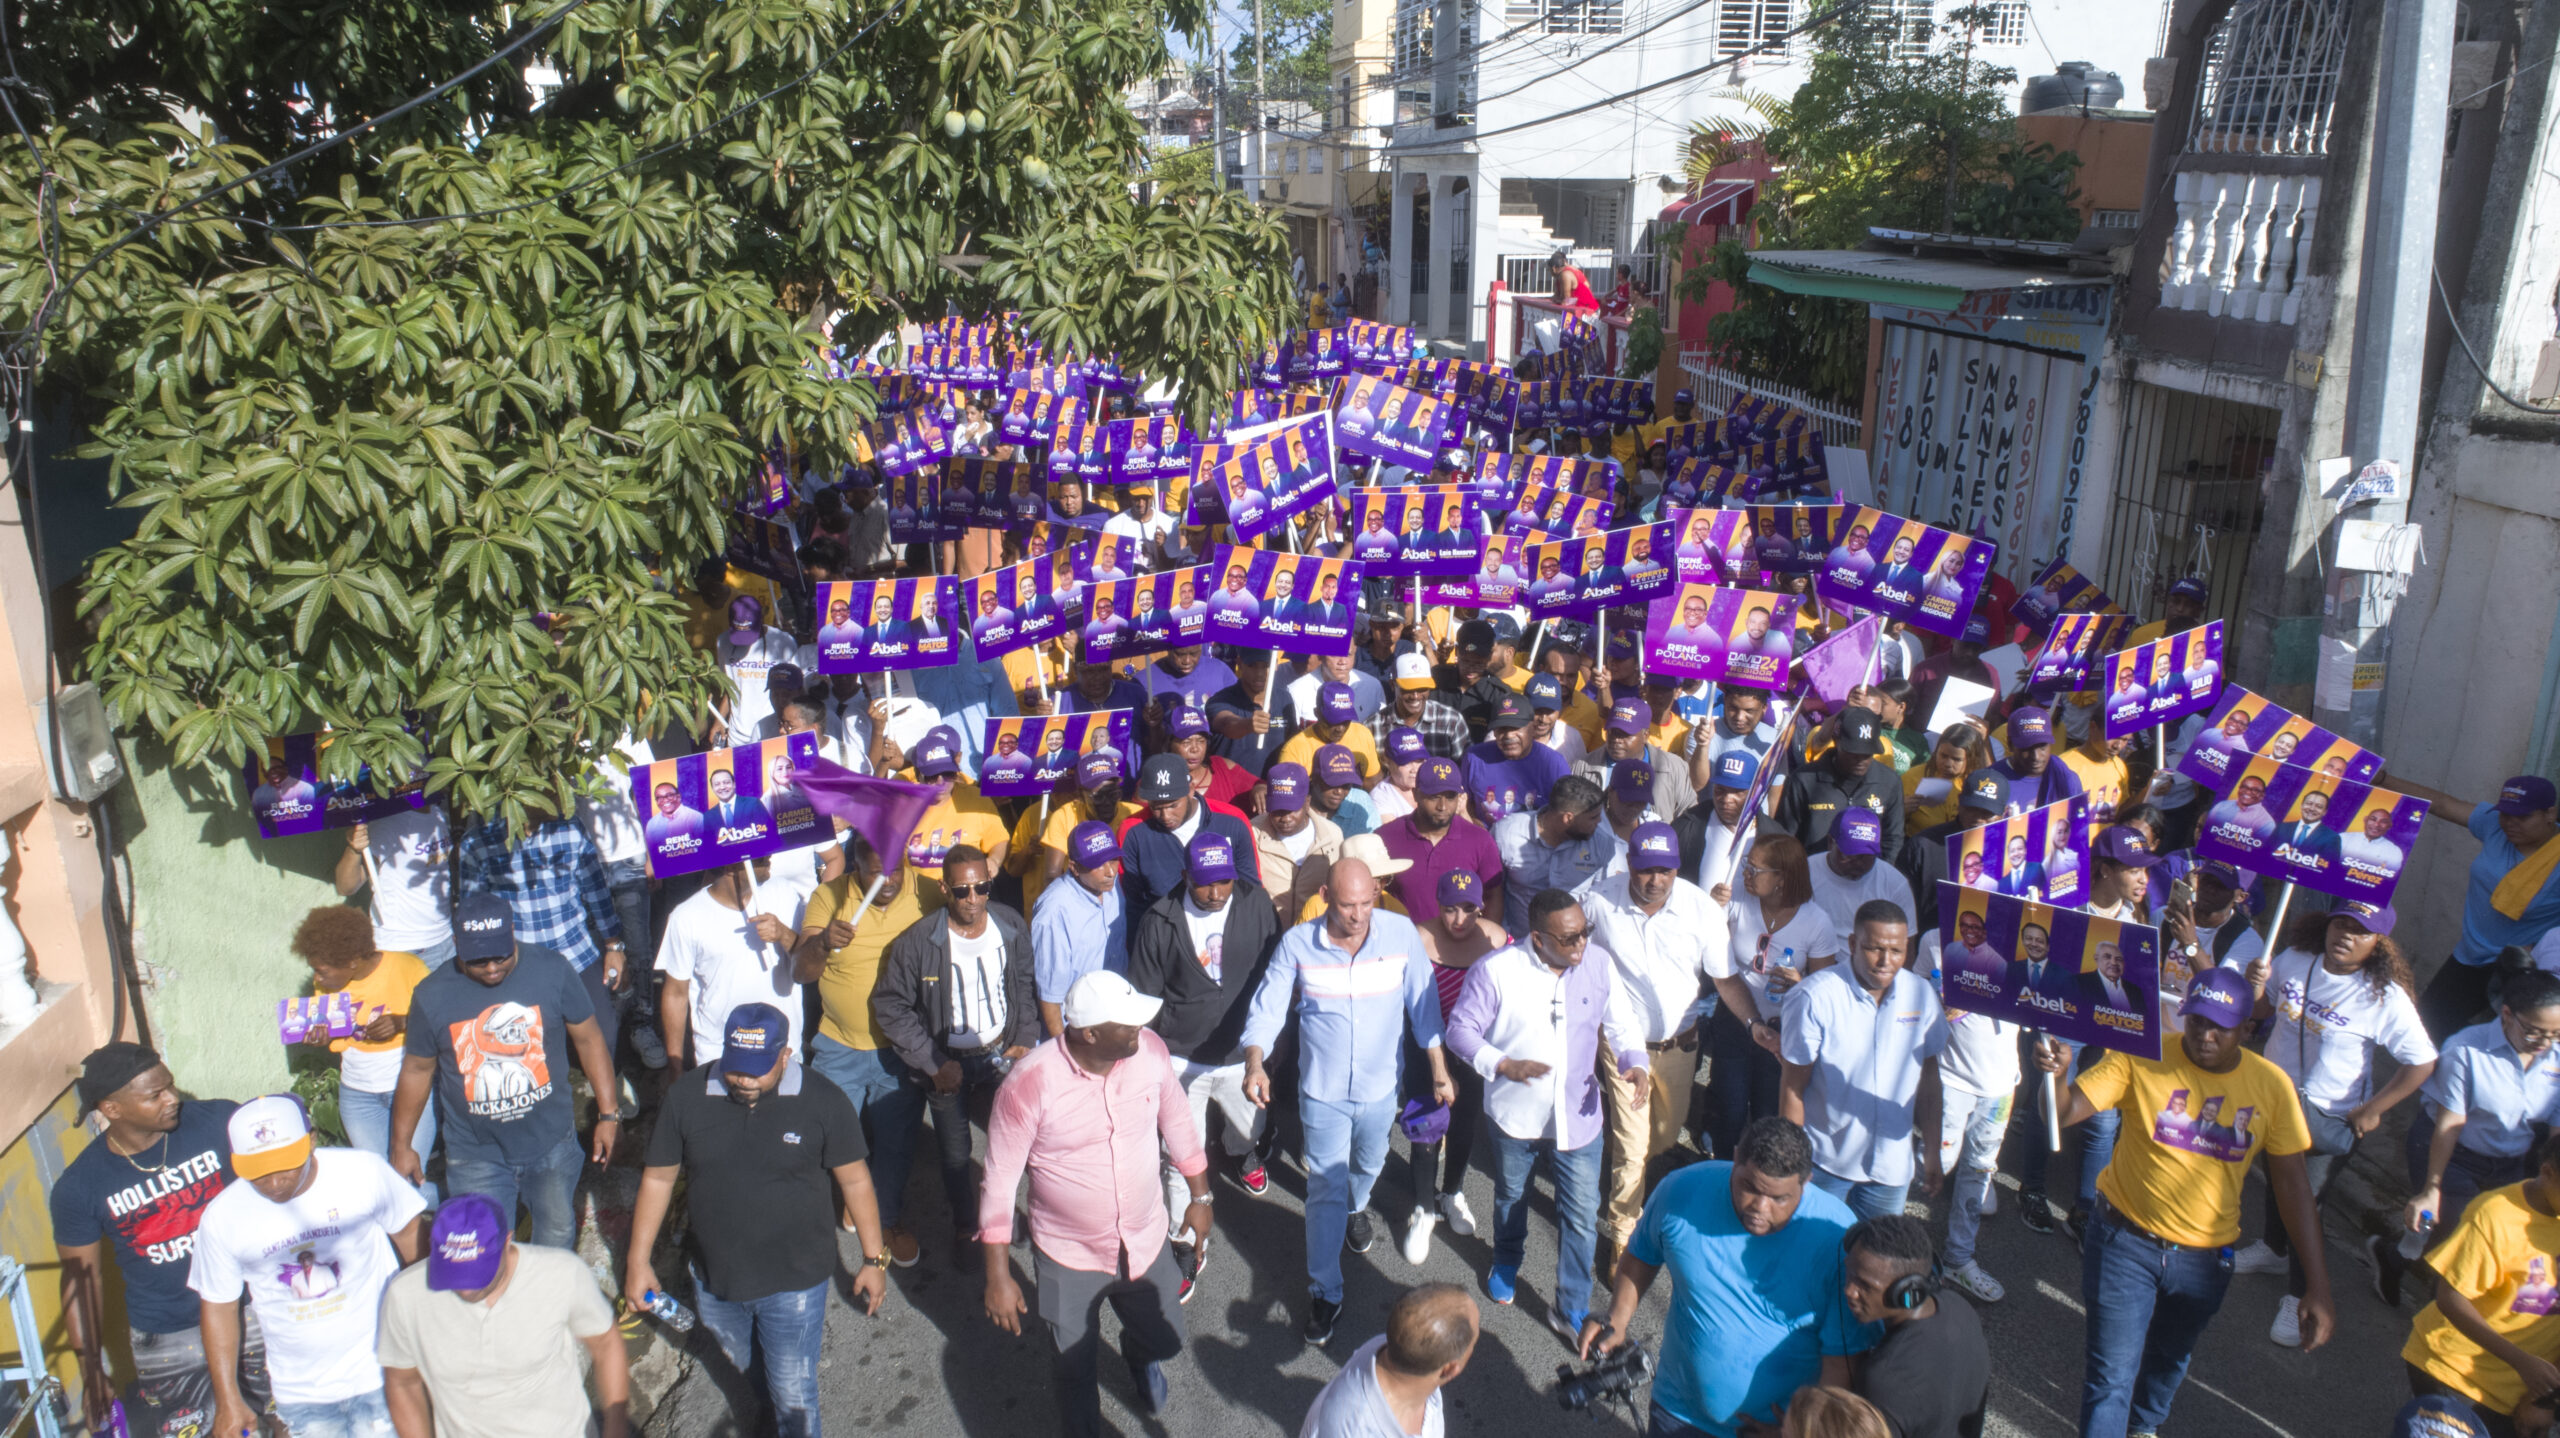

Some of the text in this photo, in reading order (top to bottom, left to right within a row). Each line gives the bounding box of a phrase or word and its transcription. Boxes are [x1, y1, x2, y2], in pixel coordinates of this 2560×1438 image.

[2017, 285, 2100, 316] SILLAS
[1122, 461, 1155, 471] POLANCO
[1129, 456, 1148, 464] RENÉ
[1457, 474, 1463, 483] 5
[1017, 505, 1037, 514] JULIO
[1238, 509, 1263, 525] POLANCO
[1631, 568, 1669, 579] ROBERTO
[1829, 570, 1863, 586] POLANCO
[1838, 567, 1857, 578] RENÉ
[1502, 586, 1514, 595] 24
[1639, 582, 1659, 590] 2024
[1537, 594, 1575, 605] POLANCO
[1544, 590, 1566, 599] RENÉ
[1926, 594, 1957, 607] CARMEN
[1214, 614, 1248, 625] POLANCO
[1222, 609, 1241, 618] RENÉ
[1921, 606, 1952, 620] REGIDORA
[1179, 614, 1203, 627] JULIO
[980, 628, 1014, 644] POLANCO
[986, 624, 1005, 636] RENÉ
[1091, 636, 1126, 646] POLANCO
[918, 643, 948, 653] MATOS
[1667, 643, 1698, 654] RENÉ
[1656, 649, 1710, 663] POLANCO
[1728, 652, 1779, 671] DAVID 24
[2190, 675, 2212, 691] JULIO
[2111, 706, 2144, 720] POLANCO
[2118, 702, 2136, 712] RENÉ
[2206, 747, 2230, 763] RENÉ
[1433, 764, 1451, 775] PLD
[1632, 770, 1649, 781] PLD
[263, 804, 313, 817] POLANCO
[271, 799, 299, 809] RENÉ
[777, 808, 811, 821] CARMEN
[778, 821, 815, 834] REGIDORA
[2223, 822, 2253, 837] RENÉ
[665, 833, 690, 844] RENÉ
[2210, 826, 2262, 848] POLANCO
[659, 838, 702, 853] POLANCO
[2342, 856, 2396, 878] Sócrates
[1452, 873, 1471, 885] PLD
[2347, 869, 2382, 885] Pérez
[1962, 970, 1989, 983] RENÉ
[1953, 974, 2001, 993] POLANCO
[2190, 982, 2226, 1003] Abel
[2095, 1005, 2144, 1021] RADHAMES
[2093, 1011, 2145, 1031] MATOS
[107, 1150, 221, 1217] HOLLISTER
[263, 1235, 299, 1258] SANTANA
